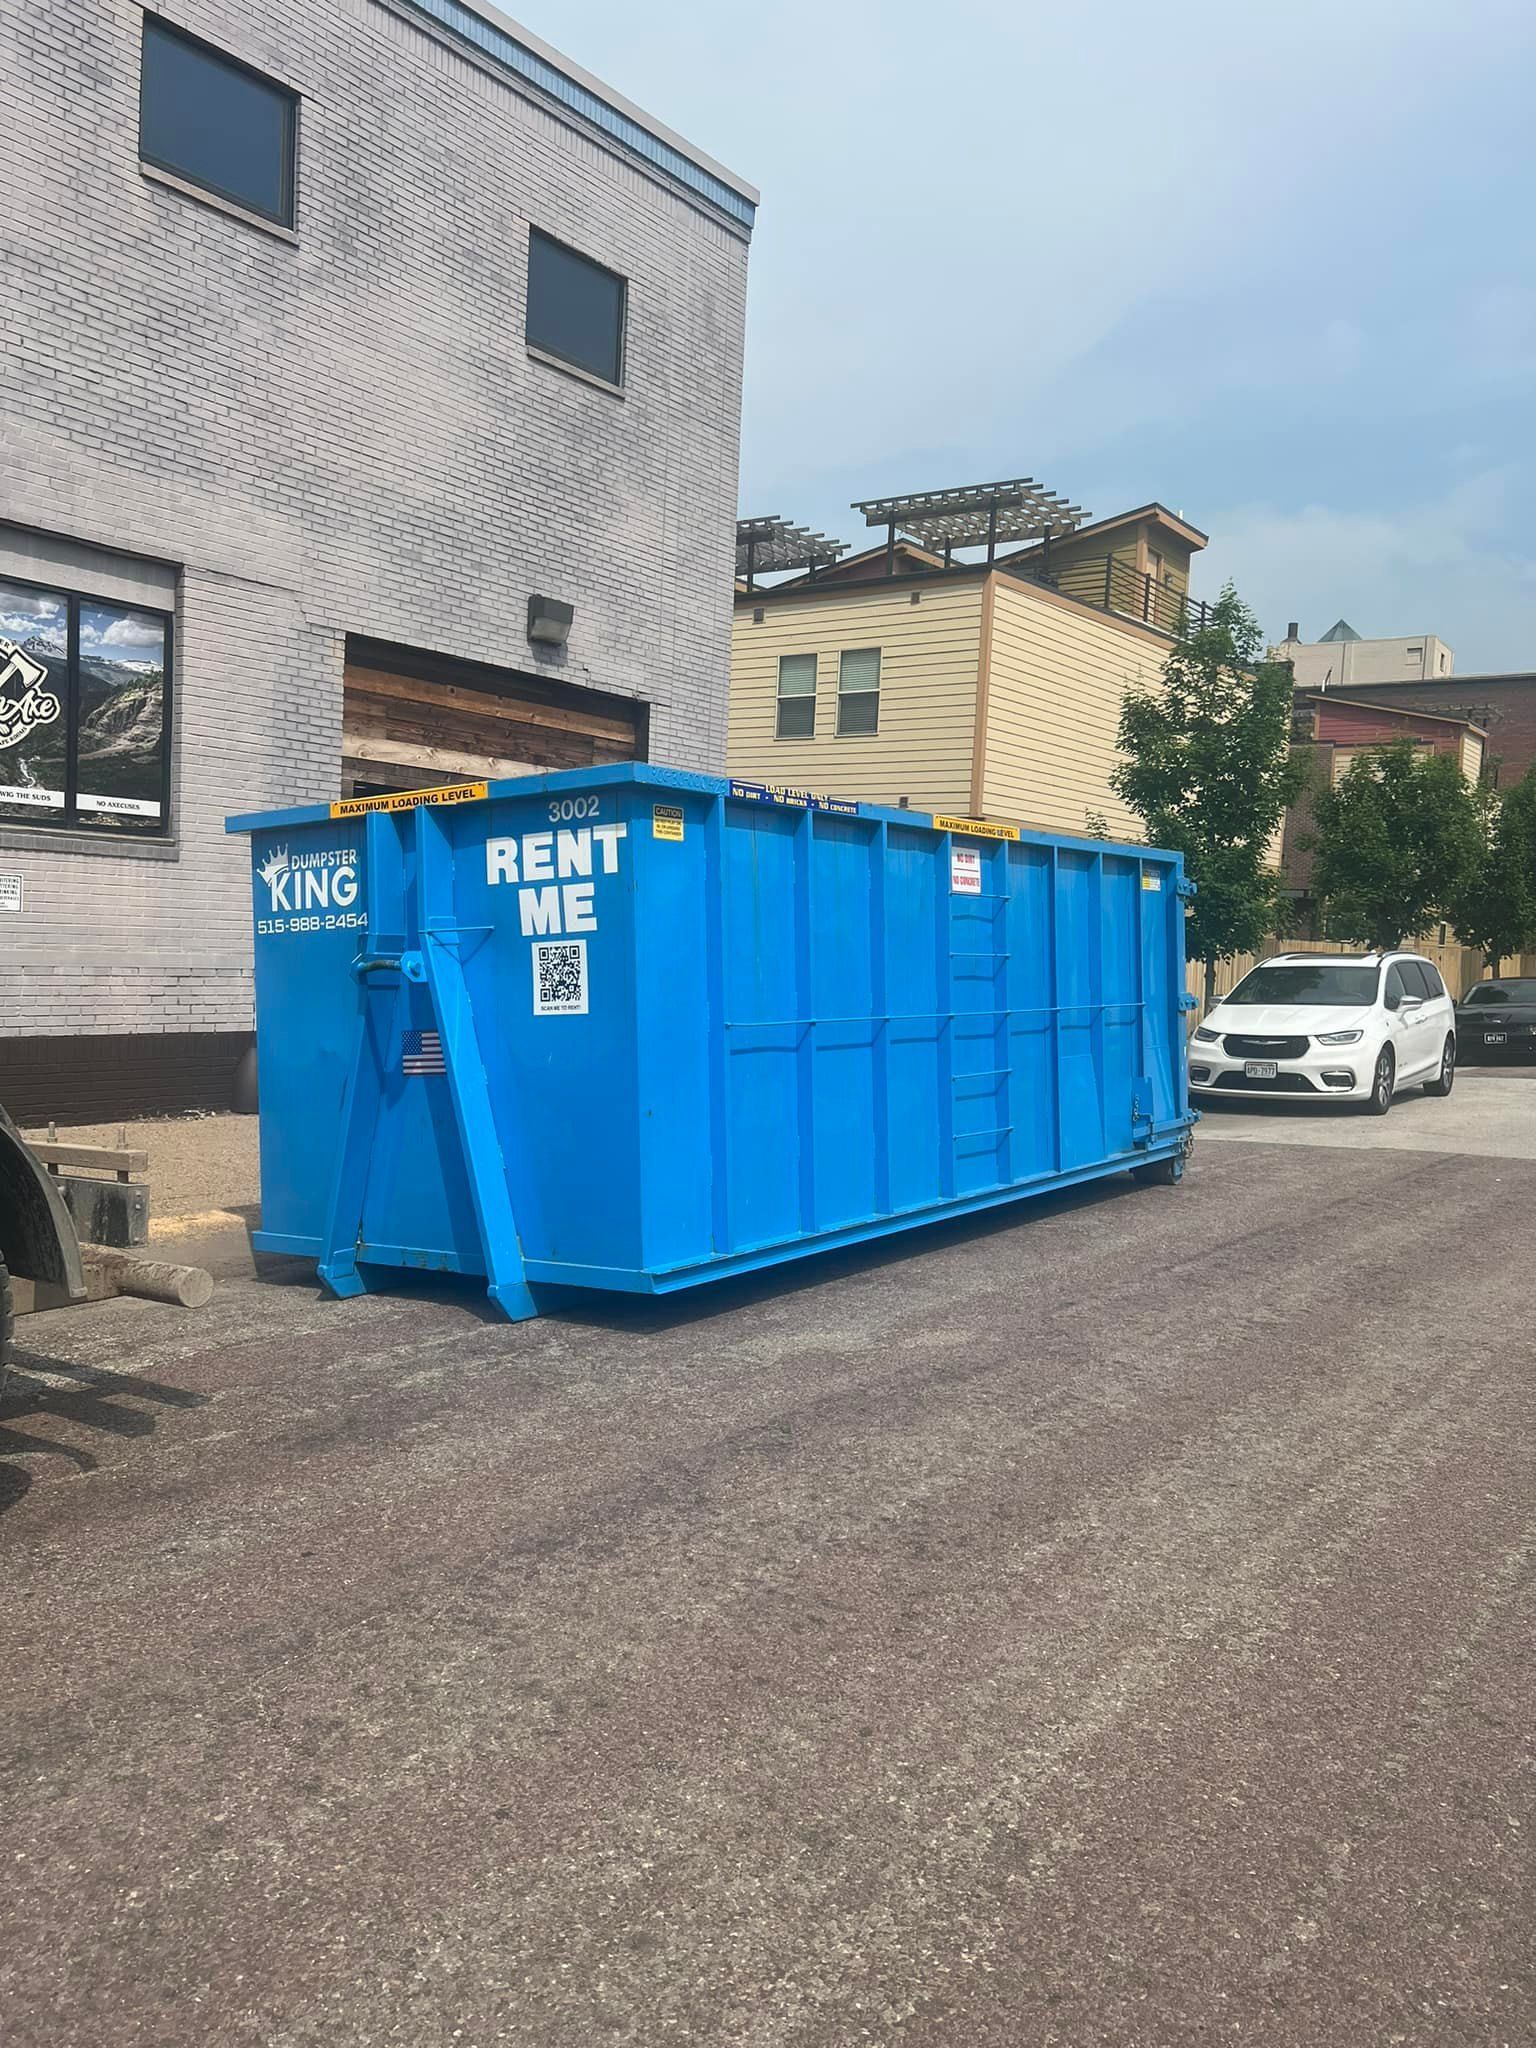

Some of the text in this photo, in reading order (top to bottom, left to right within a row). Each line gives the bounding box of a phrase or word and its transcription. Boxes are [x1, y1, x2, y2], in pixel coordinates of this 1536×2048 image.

[16, 792, 30, 800] THE
[32, 793, 52, 801] SUDS
[340, 788, 476, 814] MAXIMUM LOADING LEVEL
[732, 788, 856, 814] NO DIRT NO BRICKS NO CONCRETE
[765, 784, 786, 794] LOAD
[788, 788, 809, 799] LEVEL
[549, 795, 600, 823] 3002
[656, 807, 682, 817] CAUTION
[939, 820, 1014, 838] MAXIMUM LOADING LEVEL
[292, 849, 357, 870] DUMPSTER
[486, 822, 628, 885] RENT
[271, 866, 358, 912] KING
[518, 882, 598, 937] ME
[258, 912, 368, 934] 515-988-2454
